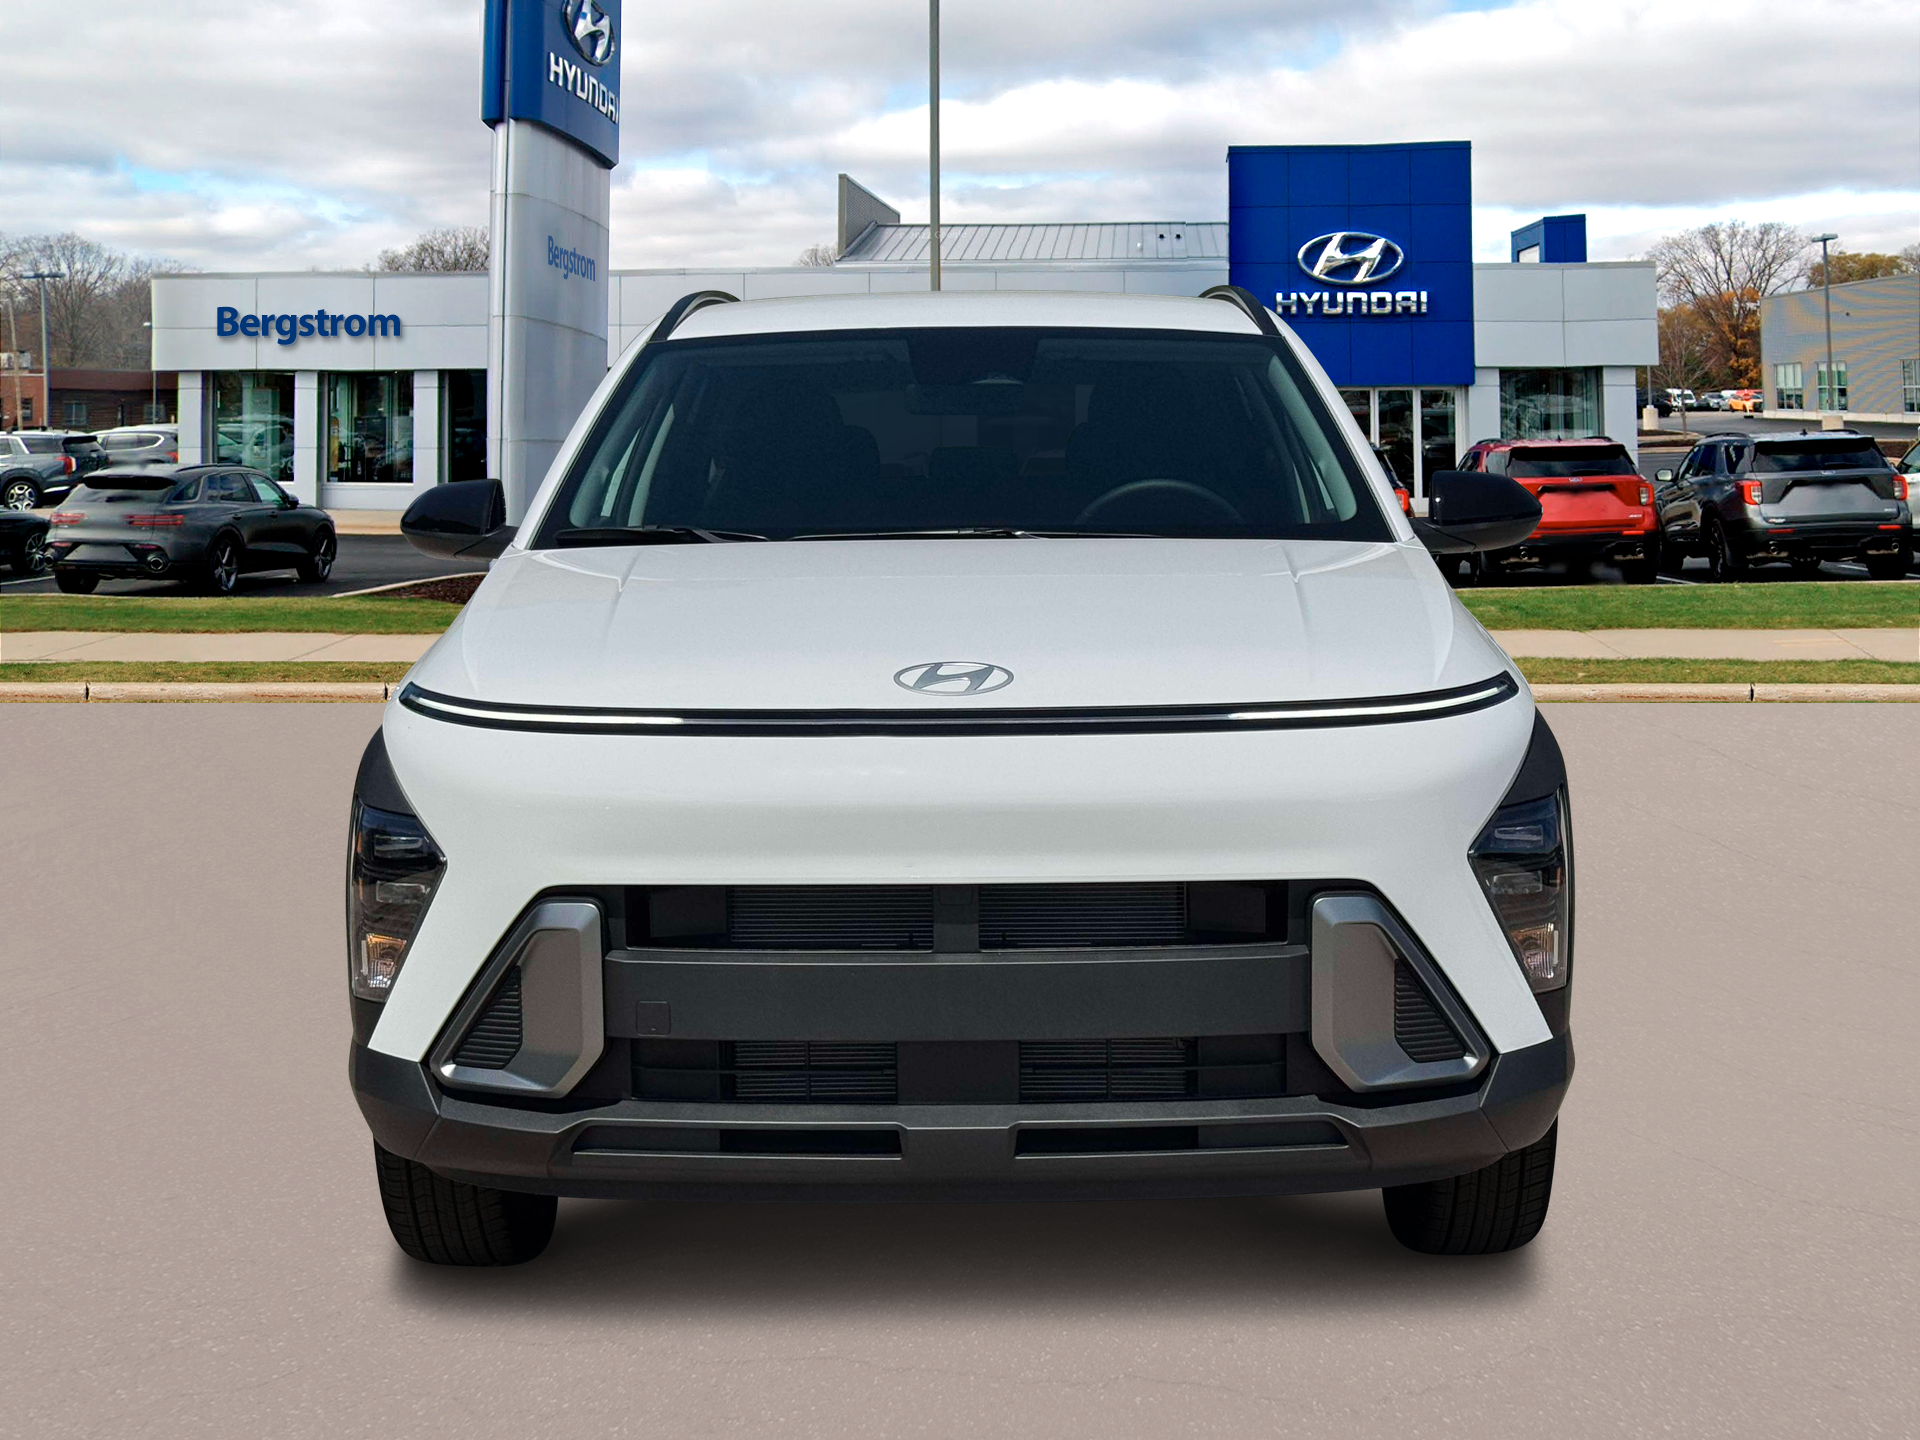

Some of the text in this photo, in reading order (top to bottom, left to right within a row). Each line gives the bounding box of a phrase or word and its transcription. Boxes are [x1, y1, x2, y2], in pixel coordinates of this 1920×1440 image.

[549, 52, 619, 124] HYUNDAI
[547, 235, 596, 281] Bergstrom
[1276, 291, 1428, 315] HYUNDAI
[216, 306, 401, 346] Bergstrom
